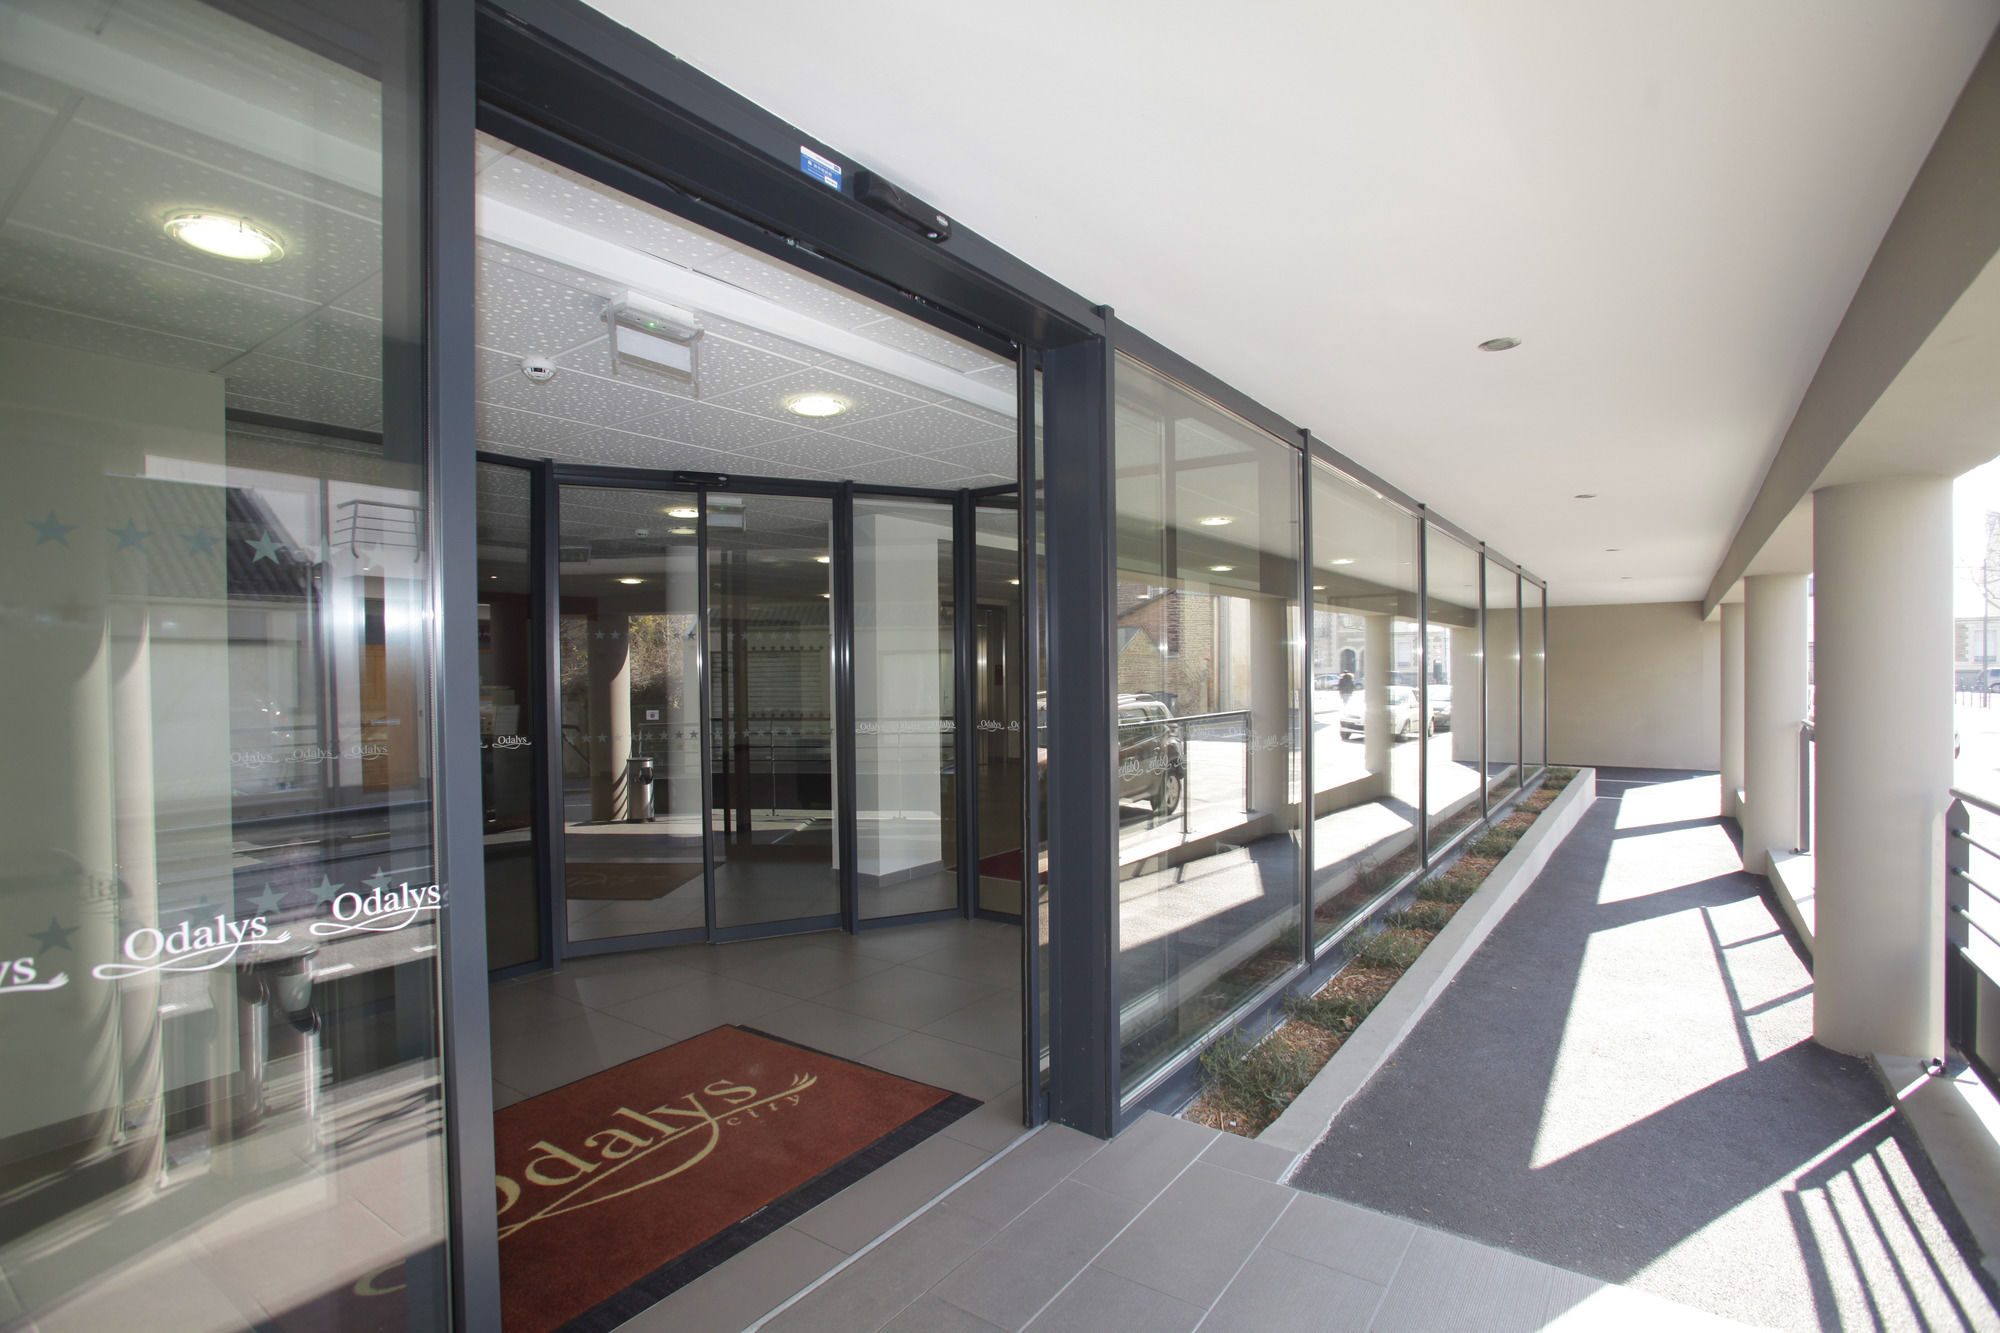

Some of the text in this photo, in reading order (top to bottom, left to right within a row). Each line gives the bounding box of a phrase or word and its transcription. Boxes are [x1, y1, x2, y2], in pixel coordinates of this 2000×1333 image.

[293, 747, 333, 763] Odalys
[351, 744, 388, 758] Odalys
[497, 735, 527, 747] Odalys
[124, 881, 441, 966] Odalys Odalys
[726, 1094, 800, 1127] city
